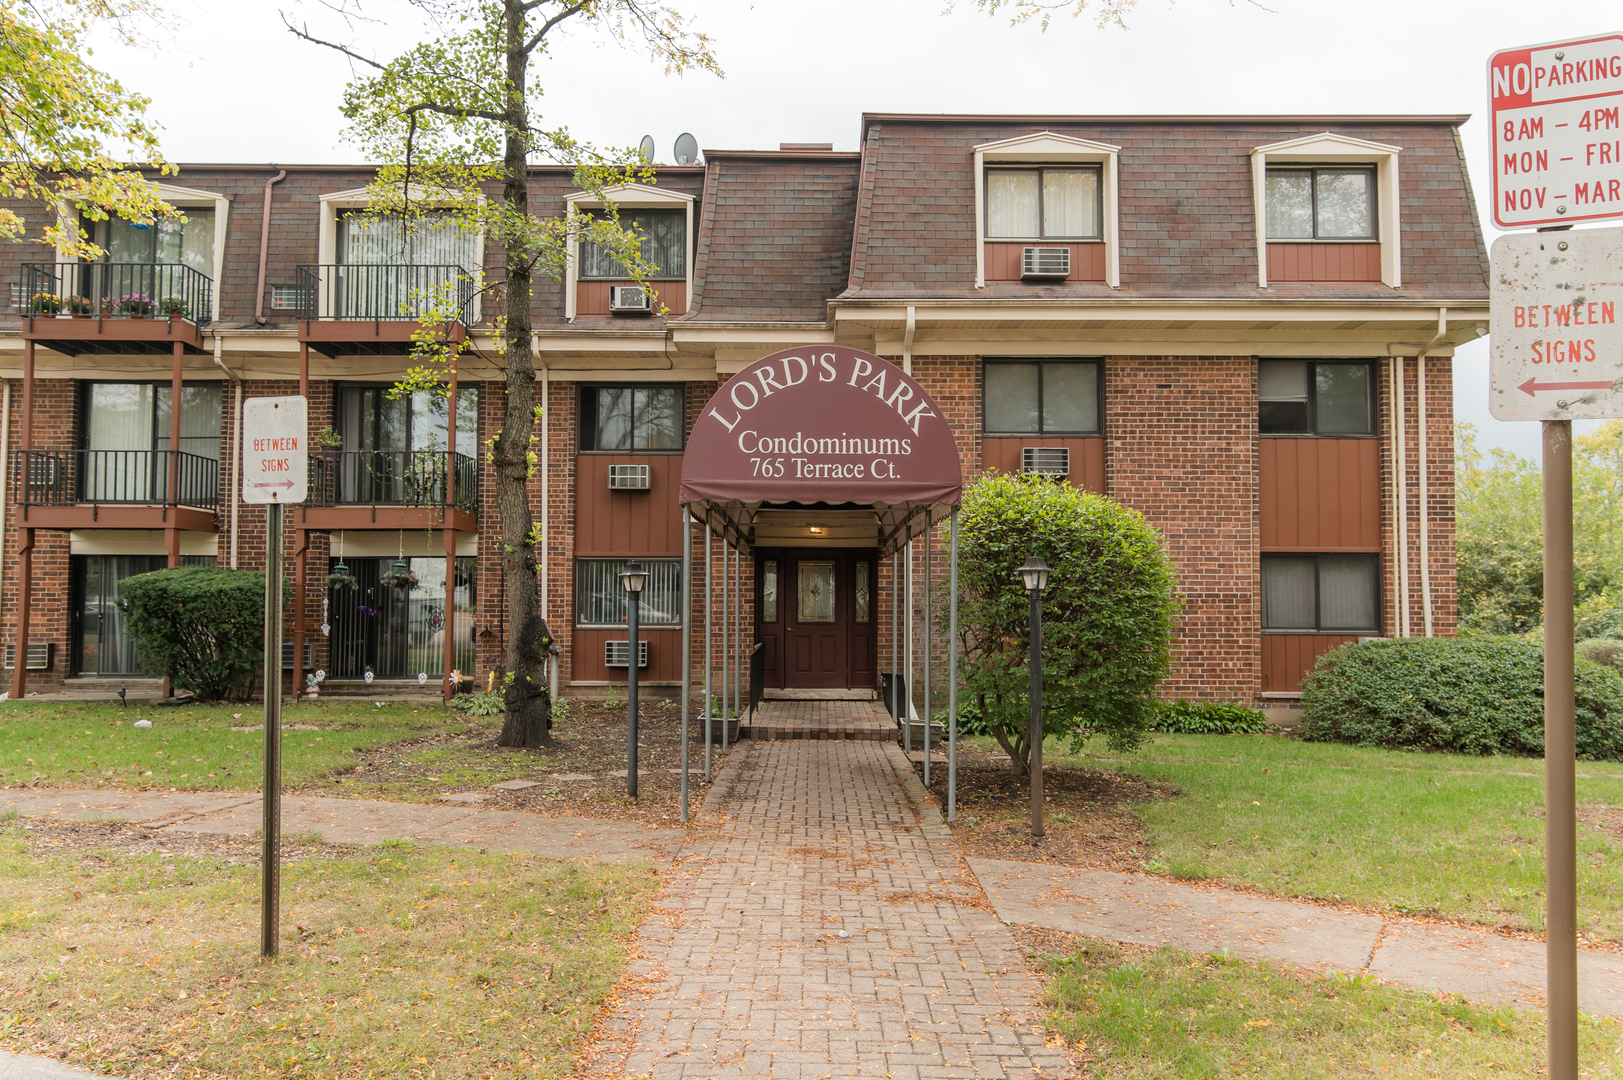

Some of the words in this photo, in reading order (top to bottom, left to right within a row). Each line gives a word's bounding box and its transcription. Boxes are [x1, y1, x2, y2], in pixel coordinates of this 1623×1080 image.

[1493, 63, 1531, 98] NO
[1534, 55, 1622, 89] PARKING
[1503, 116, 1544, 142] 8AM
[1578, 106, 1620, 132] 4PM
[1504, 149, 1548, 175] MON
[1586, 140, 1620, 166] FRI
[1505, 186, 1547, 212] NOV
[1575, 179, 1621, 205] MAR
[1514, 301, 1615, 328] BETWEEN
[1531, 339, 1596, 364] SIGNS
[708, 352, 837, 433] LORD'S
[847, 356, 937, 437] PARK
[254, 438, 297, 451] BETWEEN
[738, 430, 912, 455] Condominums
[262, 459, 289, 472] SIGNS
[749, 457, 785, 478] 765
[791, 458, 864, 478] Terrace
[870, 458, 901, 479] Ct.
